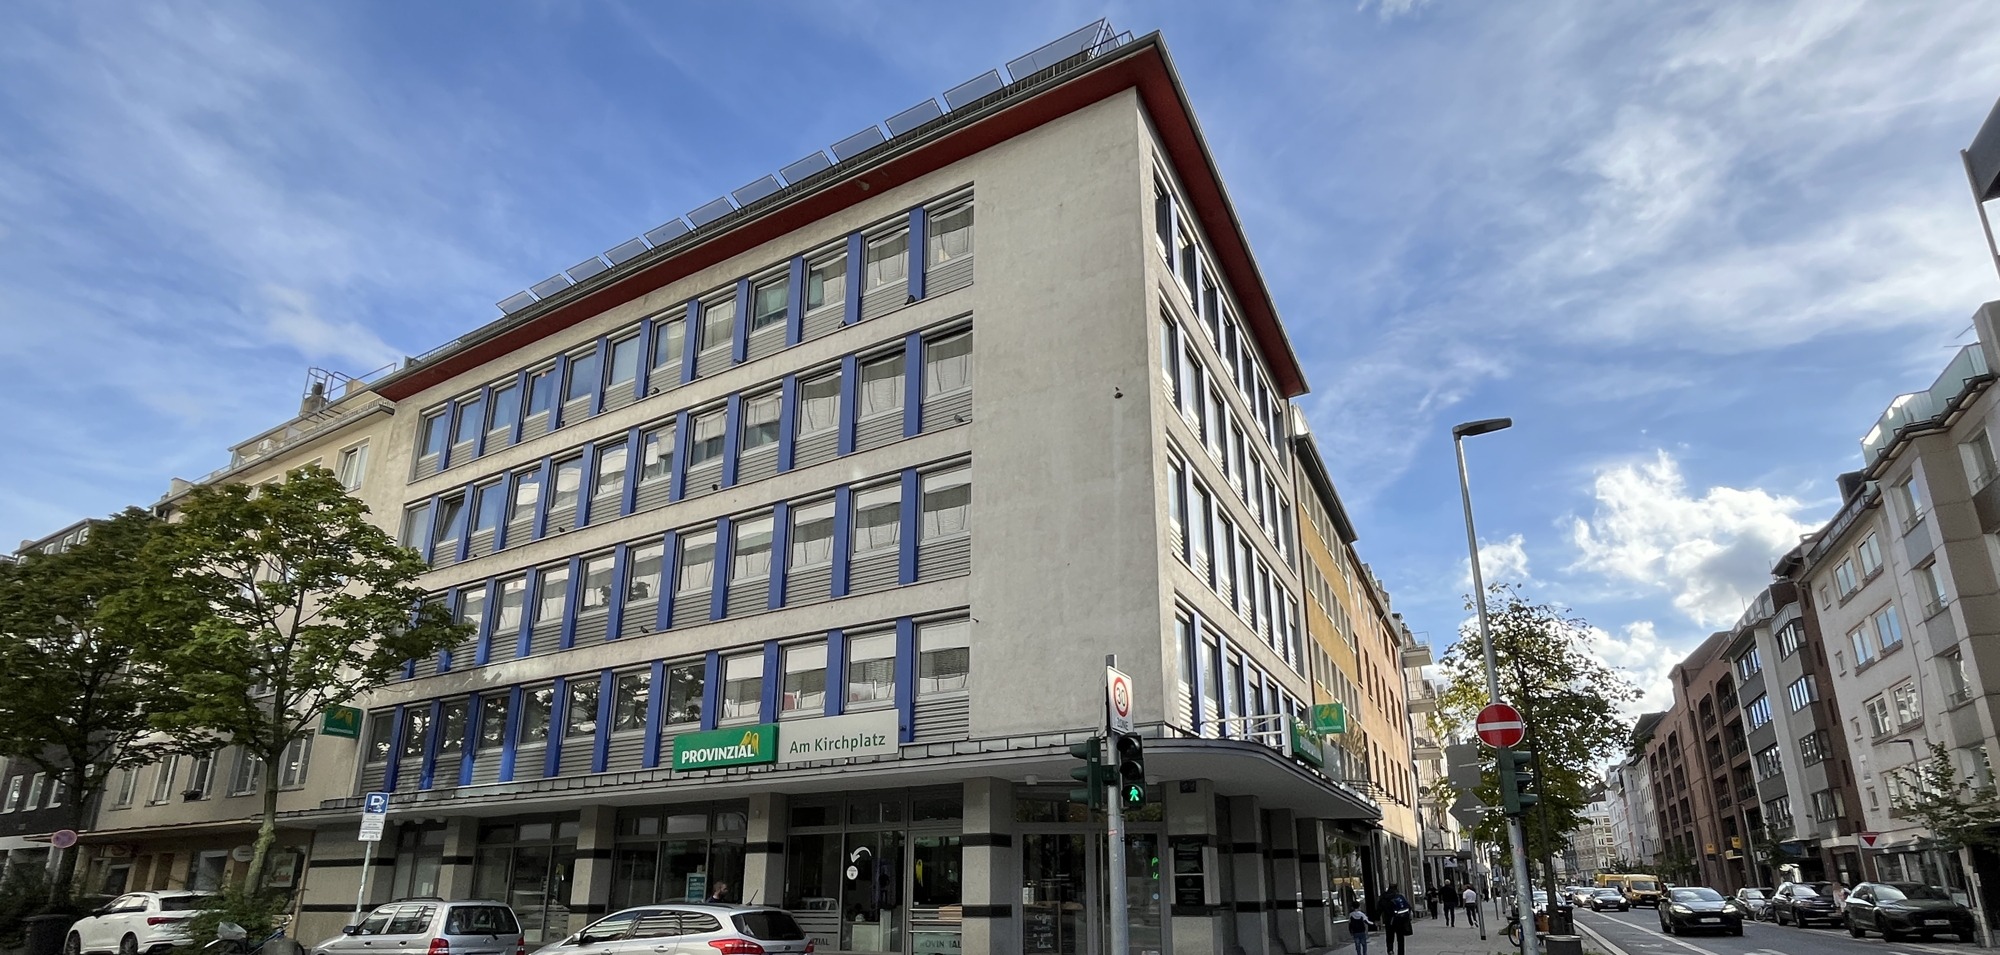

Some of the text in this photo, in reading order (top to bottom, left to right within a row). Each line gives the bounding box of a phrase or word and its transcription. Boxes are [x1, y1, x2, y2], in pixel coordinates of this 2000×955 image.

[1116, 686, 1127, 707] 30
[1116, 717, 1130, 731] ZONE
[789, 733, 887, 754] Am Kirchplatz
[680, 745, 755, 764] PROVINZIAL
